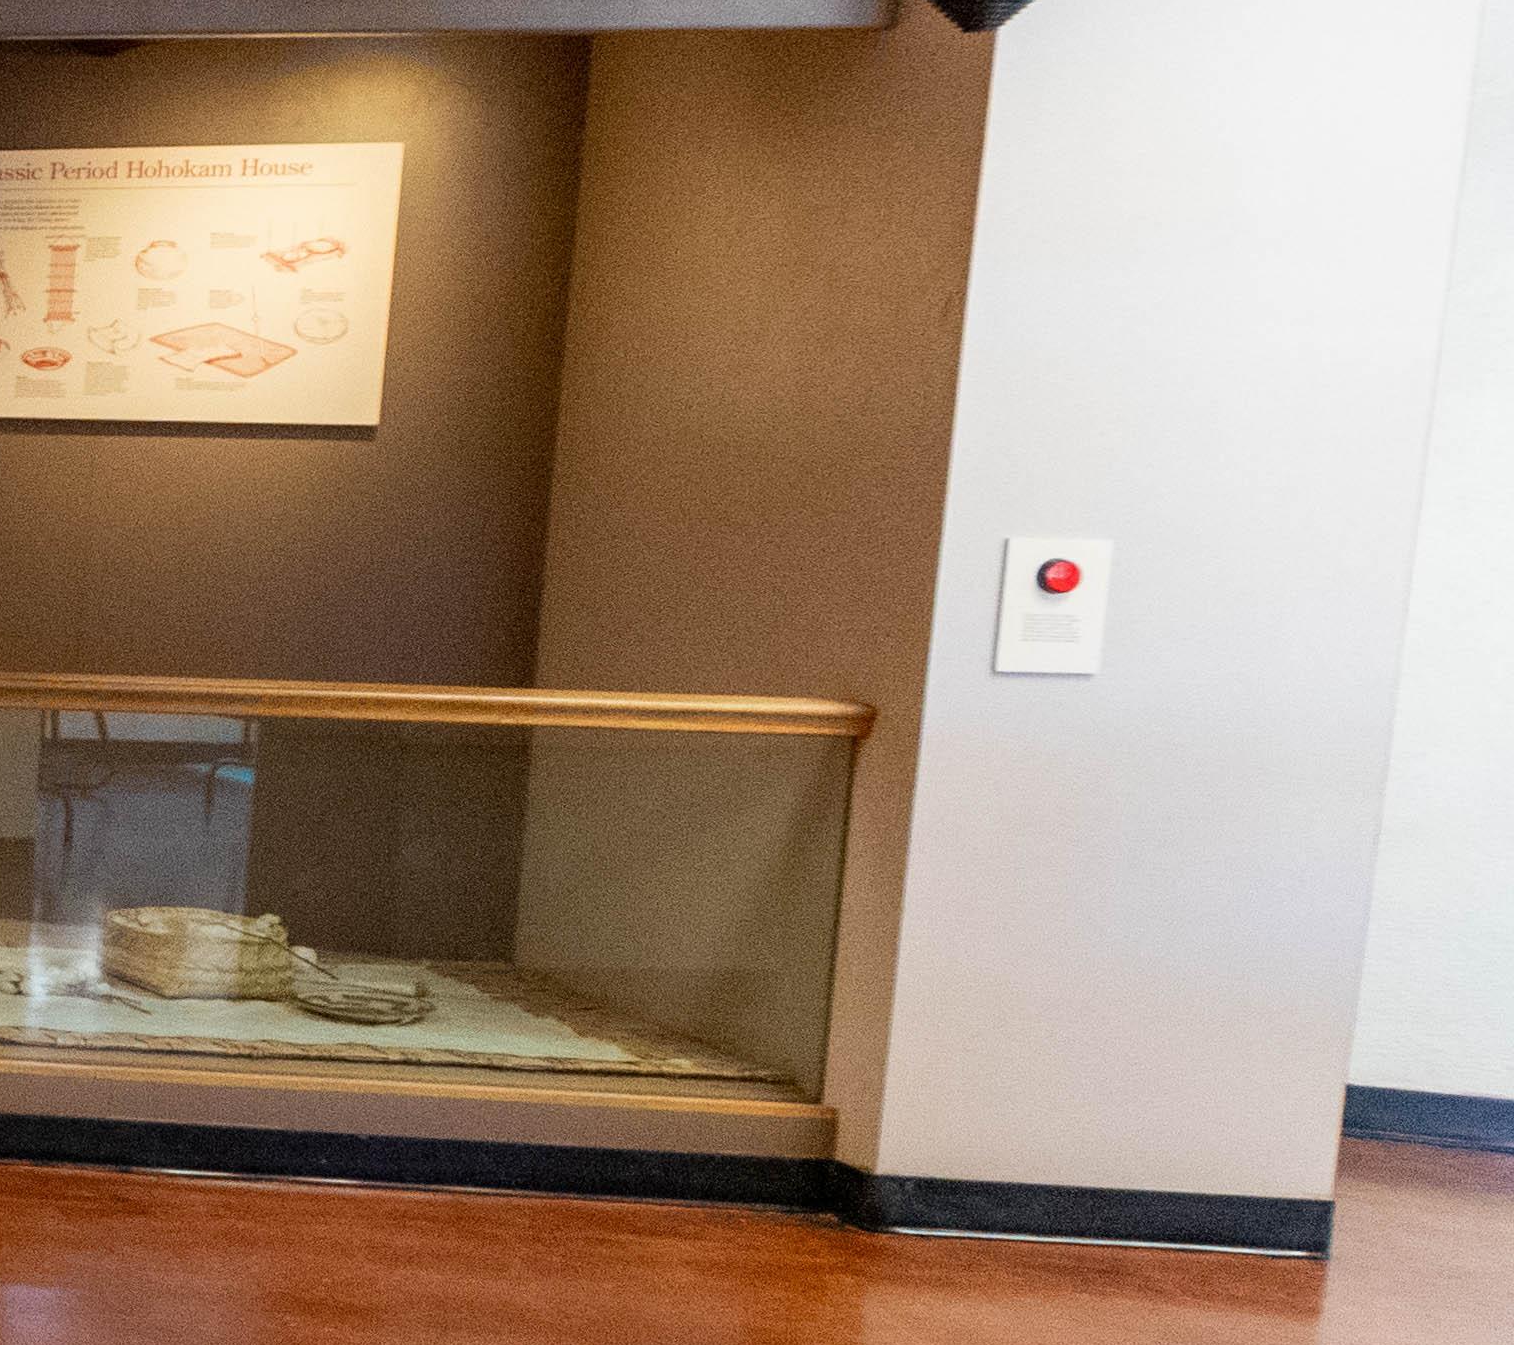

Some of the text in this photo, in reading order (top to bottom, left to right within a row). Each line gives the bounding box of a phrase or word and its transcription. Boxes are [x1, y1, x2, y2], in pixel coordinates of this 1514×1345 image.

[50, 161, 118, 180] Period
[126, 159, 232, 179] Hohokam
[241, 158, 313, 177] House
